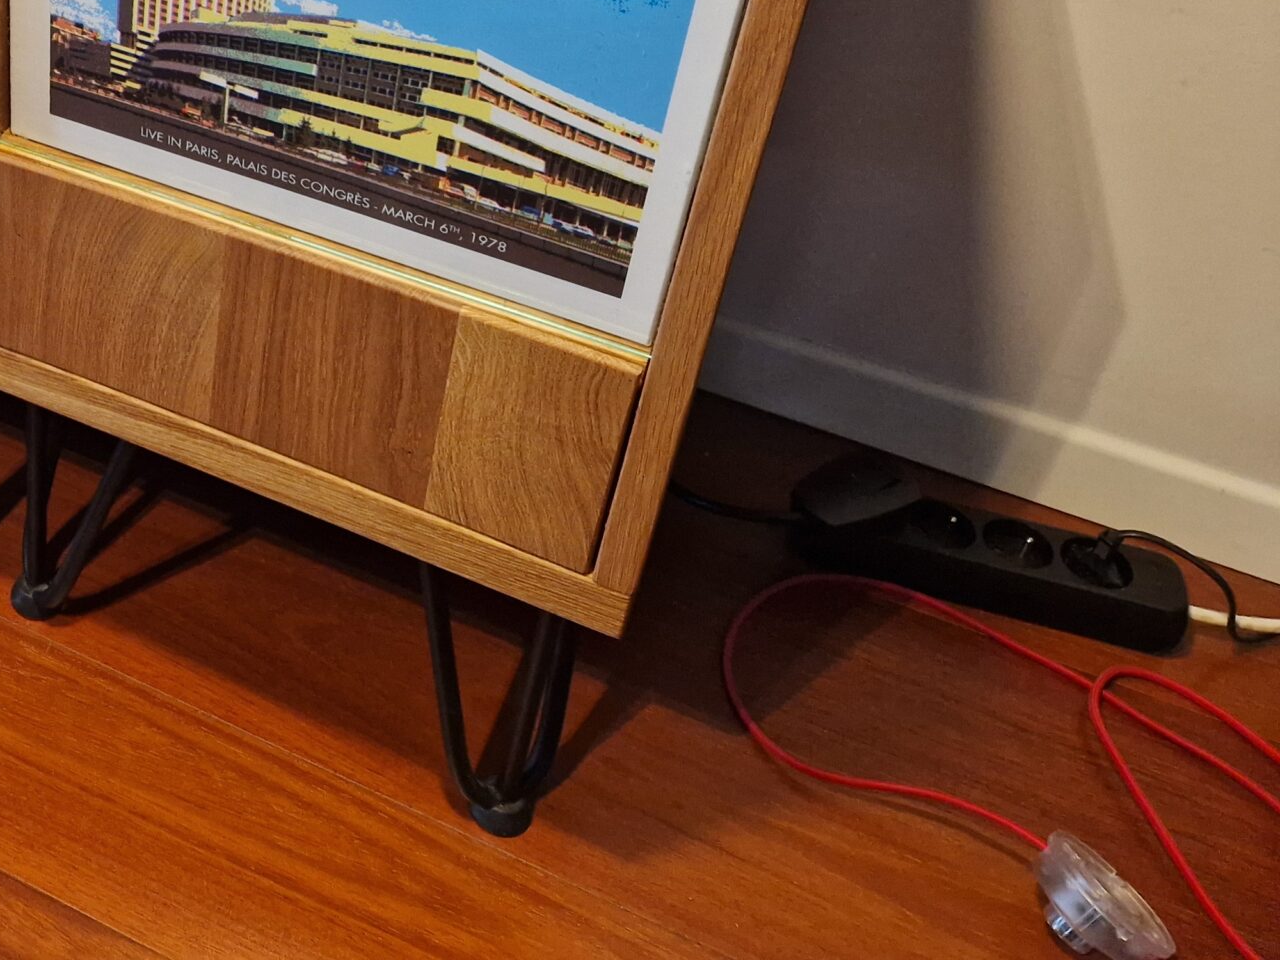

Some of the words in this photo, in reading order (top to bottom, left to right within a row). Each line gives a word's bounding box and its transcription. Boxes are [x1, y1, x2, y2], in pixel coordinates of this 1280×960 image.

[140, 126, 164, 143] LIVE
[167, 135, 182, 149] IN
[185, 141, 222, 163] PARIS,
[226, 154, 268, 176] PALAIS
[271, 168, 297, 185] DES
[300, 178, 371, 209] CONGRÈS
[381, 204, 435, 230] MARCH
[470, 231, 508, 253] 1978
